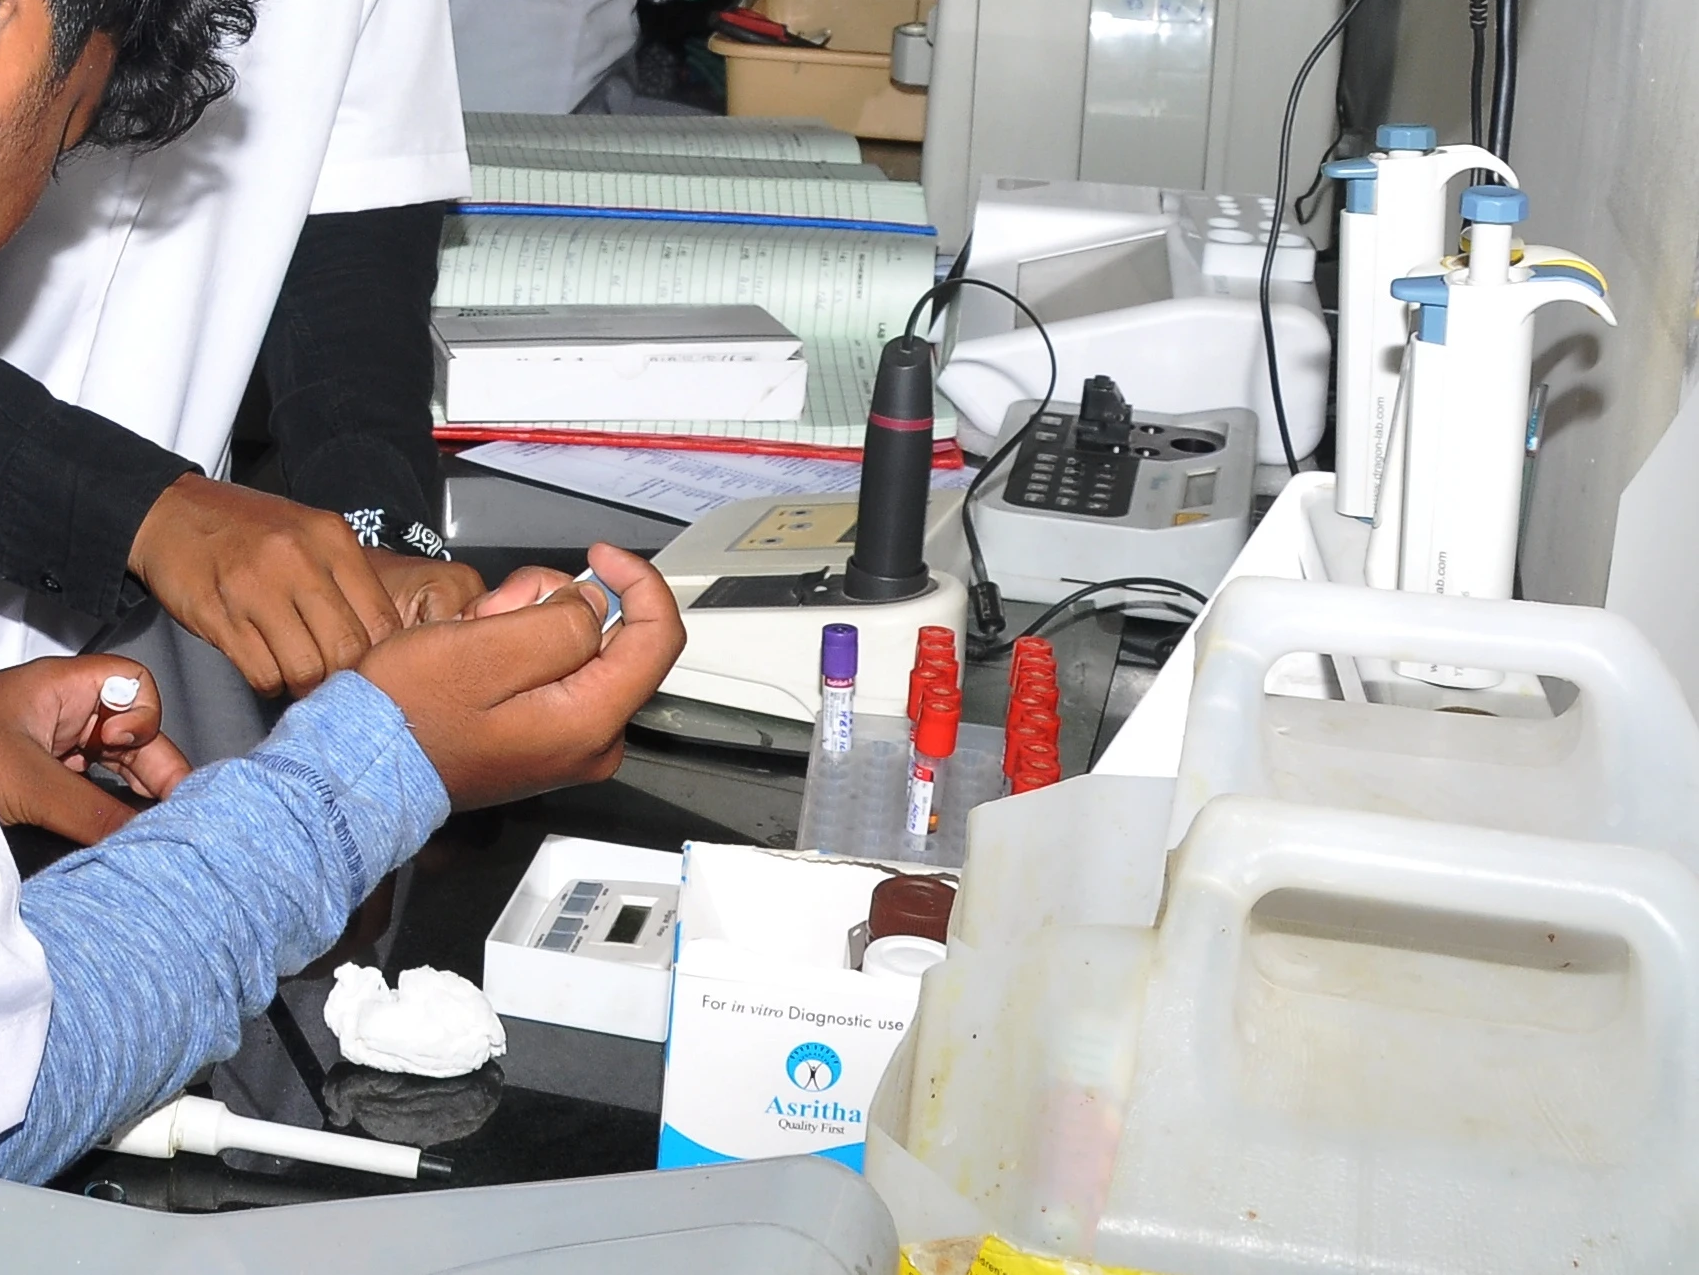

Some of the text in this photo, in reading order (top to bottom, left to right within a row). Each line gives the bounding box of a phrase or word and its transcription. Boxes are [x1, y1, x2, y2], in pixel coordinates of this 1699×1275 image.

[702, 994, 904, 1032] For in vitro Diagnostic use
[764, 1095, 862, 1123] Asritha
[778, 1118, 845, 1135] Quality First
